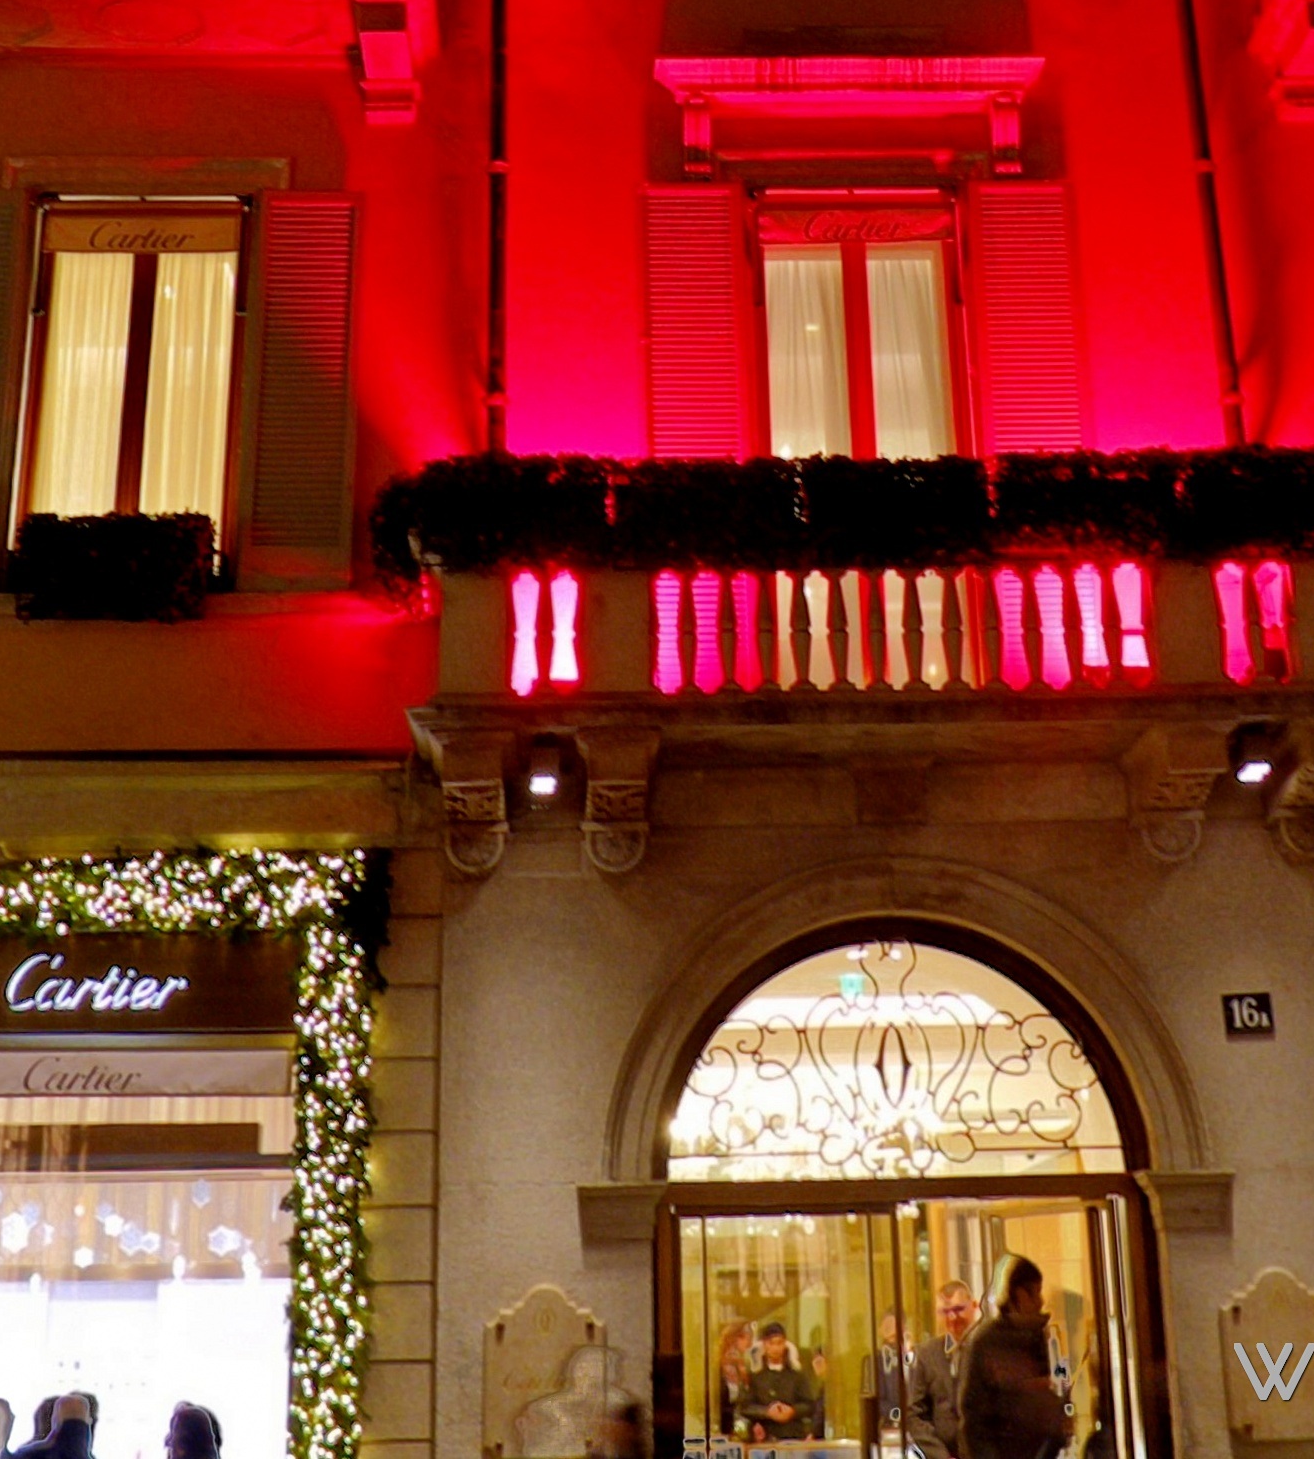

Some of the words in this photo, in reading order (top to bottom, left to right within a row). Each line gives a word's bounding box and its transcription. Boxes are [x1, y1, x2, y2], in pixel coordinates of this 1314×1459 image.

[88, 220, 196, 249] Cartier
[804, 210, 904, 240] Cartier
[6, 953, 189, 1012] Cartier
[23, 1056, 141, 1091] Cartier
